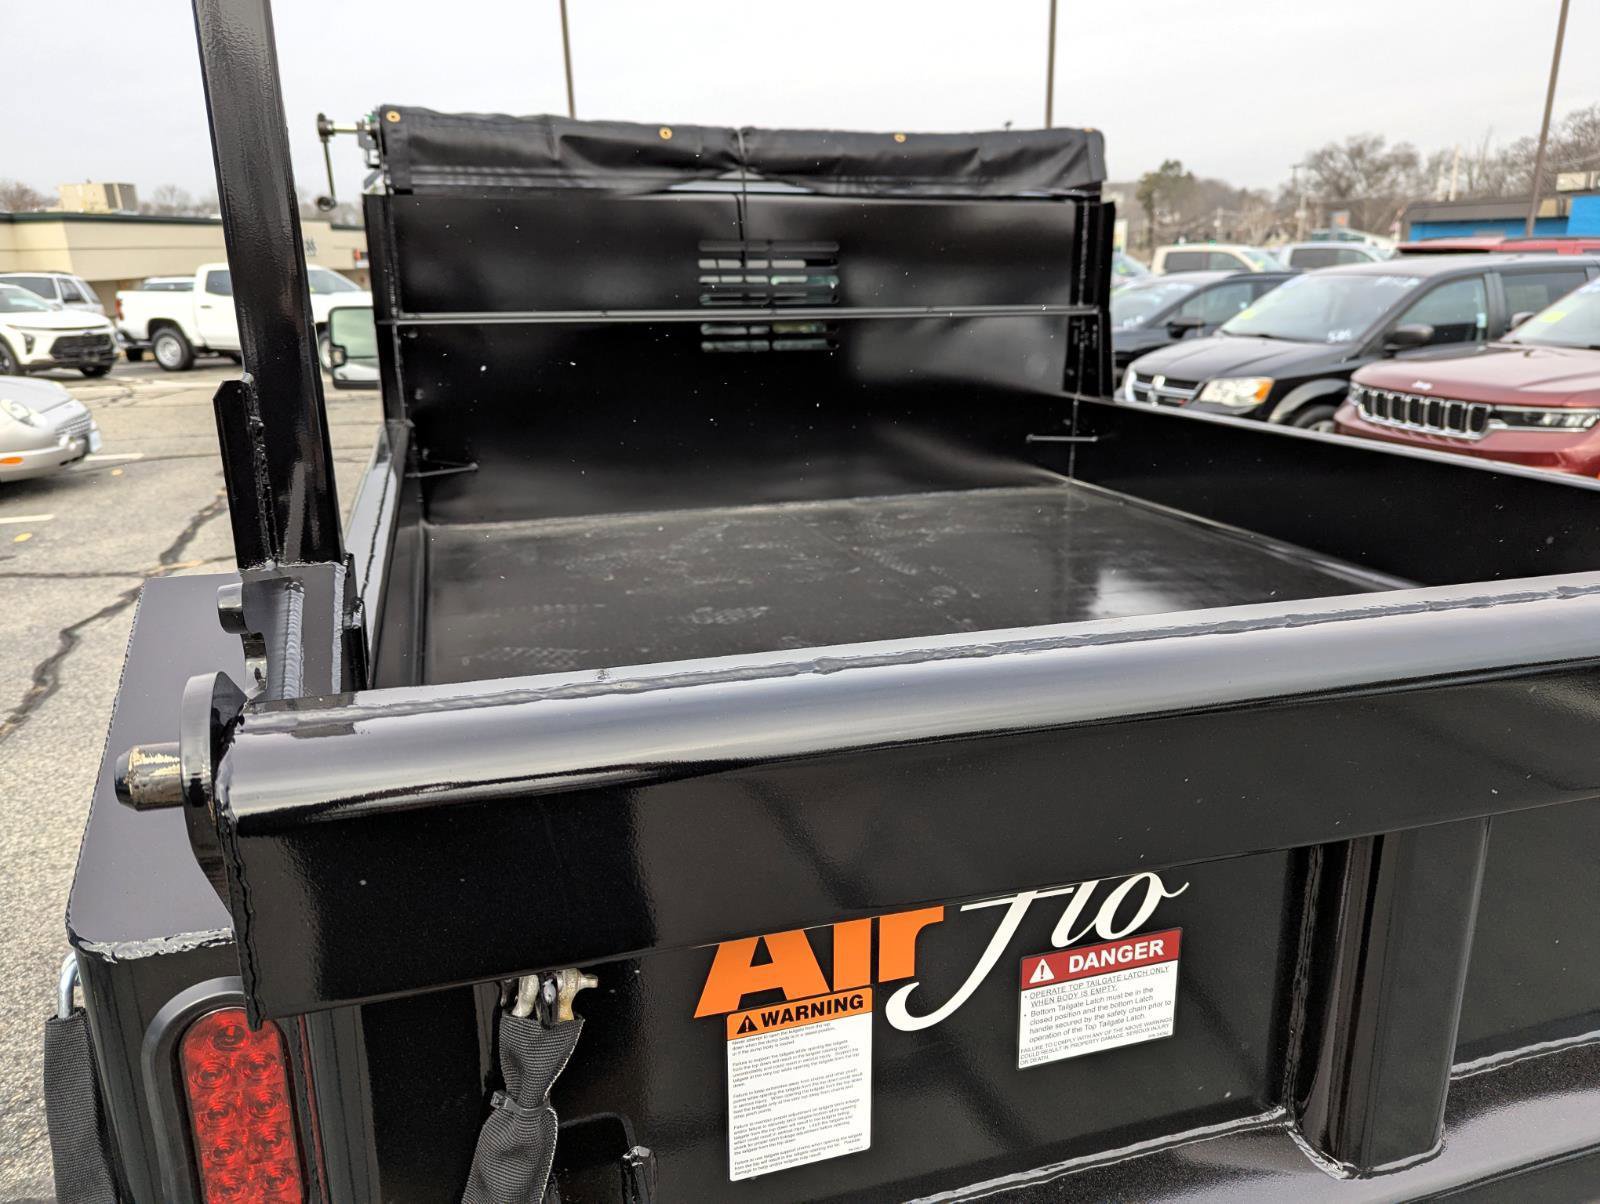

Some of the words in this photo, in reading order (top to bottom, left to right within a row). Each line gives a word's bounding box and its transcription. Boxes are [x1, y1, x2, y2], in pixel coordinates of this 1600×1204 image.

[1068, 939, 1164, 973] DANGER
[1029, 985, 1065, 999] OPERATE
[1068, 982, 1084, 992] TOP
[1086, 974, 1121, 988] TAILGATE
[1123, 969, 1147, 981] LATCH
[1149, 965, 1168, 975] ONLY
[1030, 996, 1054, 1007] WHEN
[1056, 992, 1077, 1002] BODY
[1080, 989, 1087, 997] IS
[761, 994, 864, 1028] WARNING
[1029, 1014, 1052, 1026] closed
[1054, 1009, 1080, 1021] position
[1082, 1006, 1095, 1015] and
[1097, 1003, 1108, 1012] the
[1110, 998, 1133, 1009] bottom
[1135, 994, 1153, 1004] Latch
[1029, 1023, 1053, 1034] handle
[1055, 1017, 1082, 1029] secured
[1084, 1015, 1092, 1023] by
[1094, 1012, 1104, 1021] the
[1106, 1008, 1126, 1018] safety
[1128, 1004, 1146, 1014] chain
[1148, 1000, 1163, 1010] prior
[1030, 1006, 1055, 1017] Bottom
[1057, 1000, 1083, 1012] Tailgate
[1085, 996, 1104, 1006] Latch
[1106, 992, 1122, 1002] must
[1124, 990, 1133, 998] be
[1134, 988, 1141, 996] in
[1142, 986, 1153, 994] the
[1029, 1029, 1061, 1043] operation
[1071, 1025, 1082, 1034] the
[1085, 1022, 1096, 1031] Top
[1099, 1016, 1124, 1028] Tailgate
